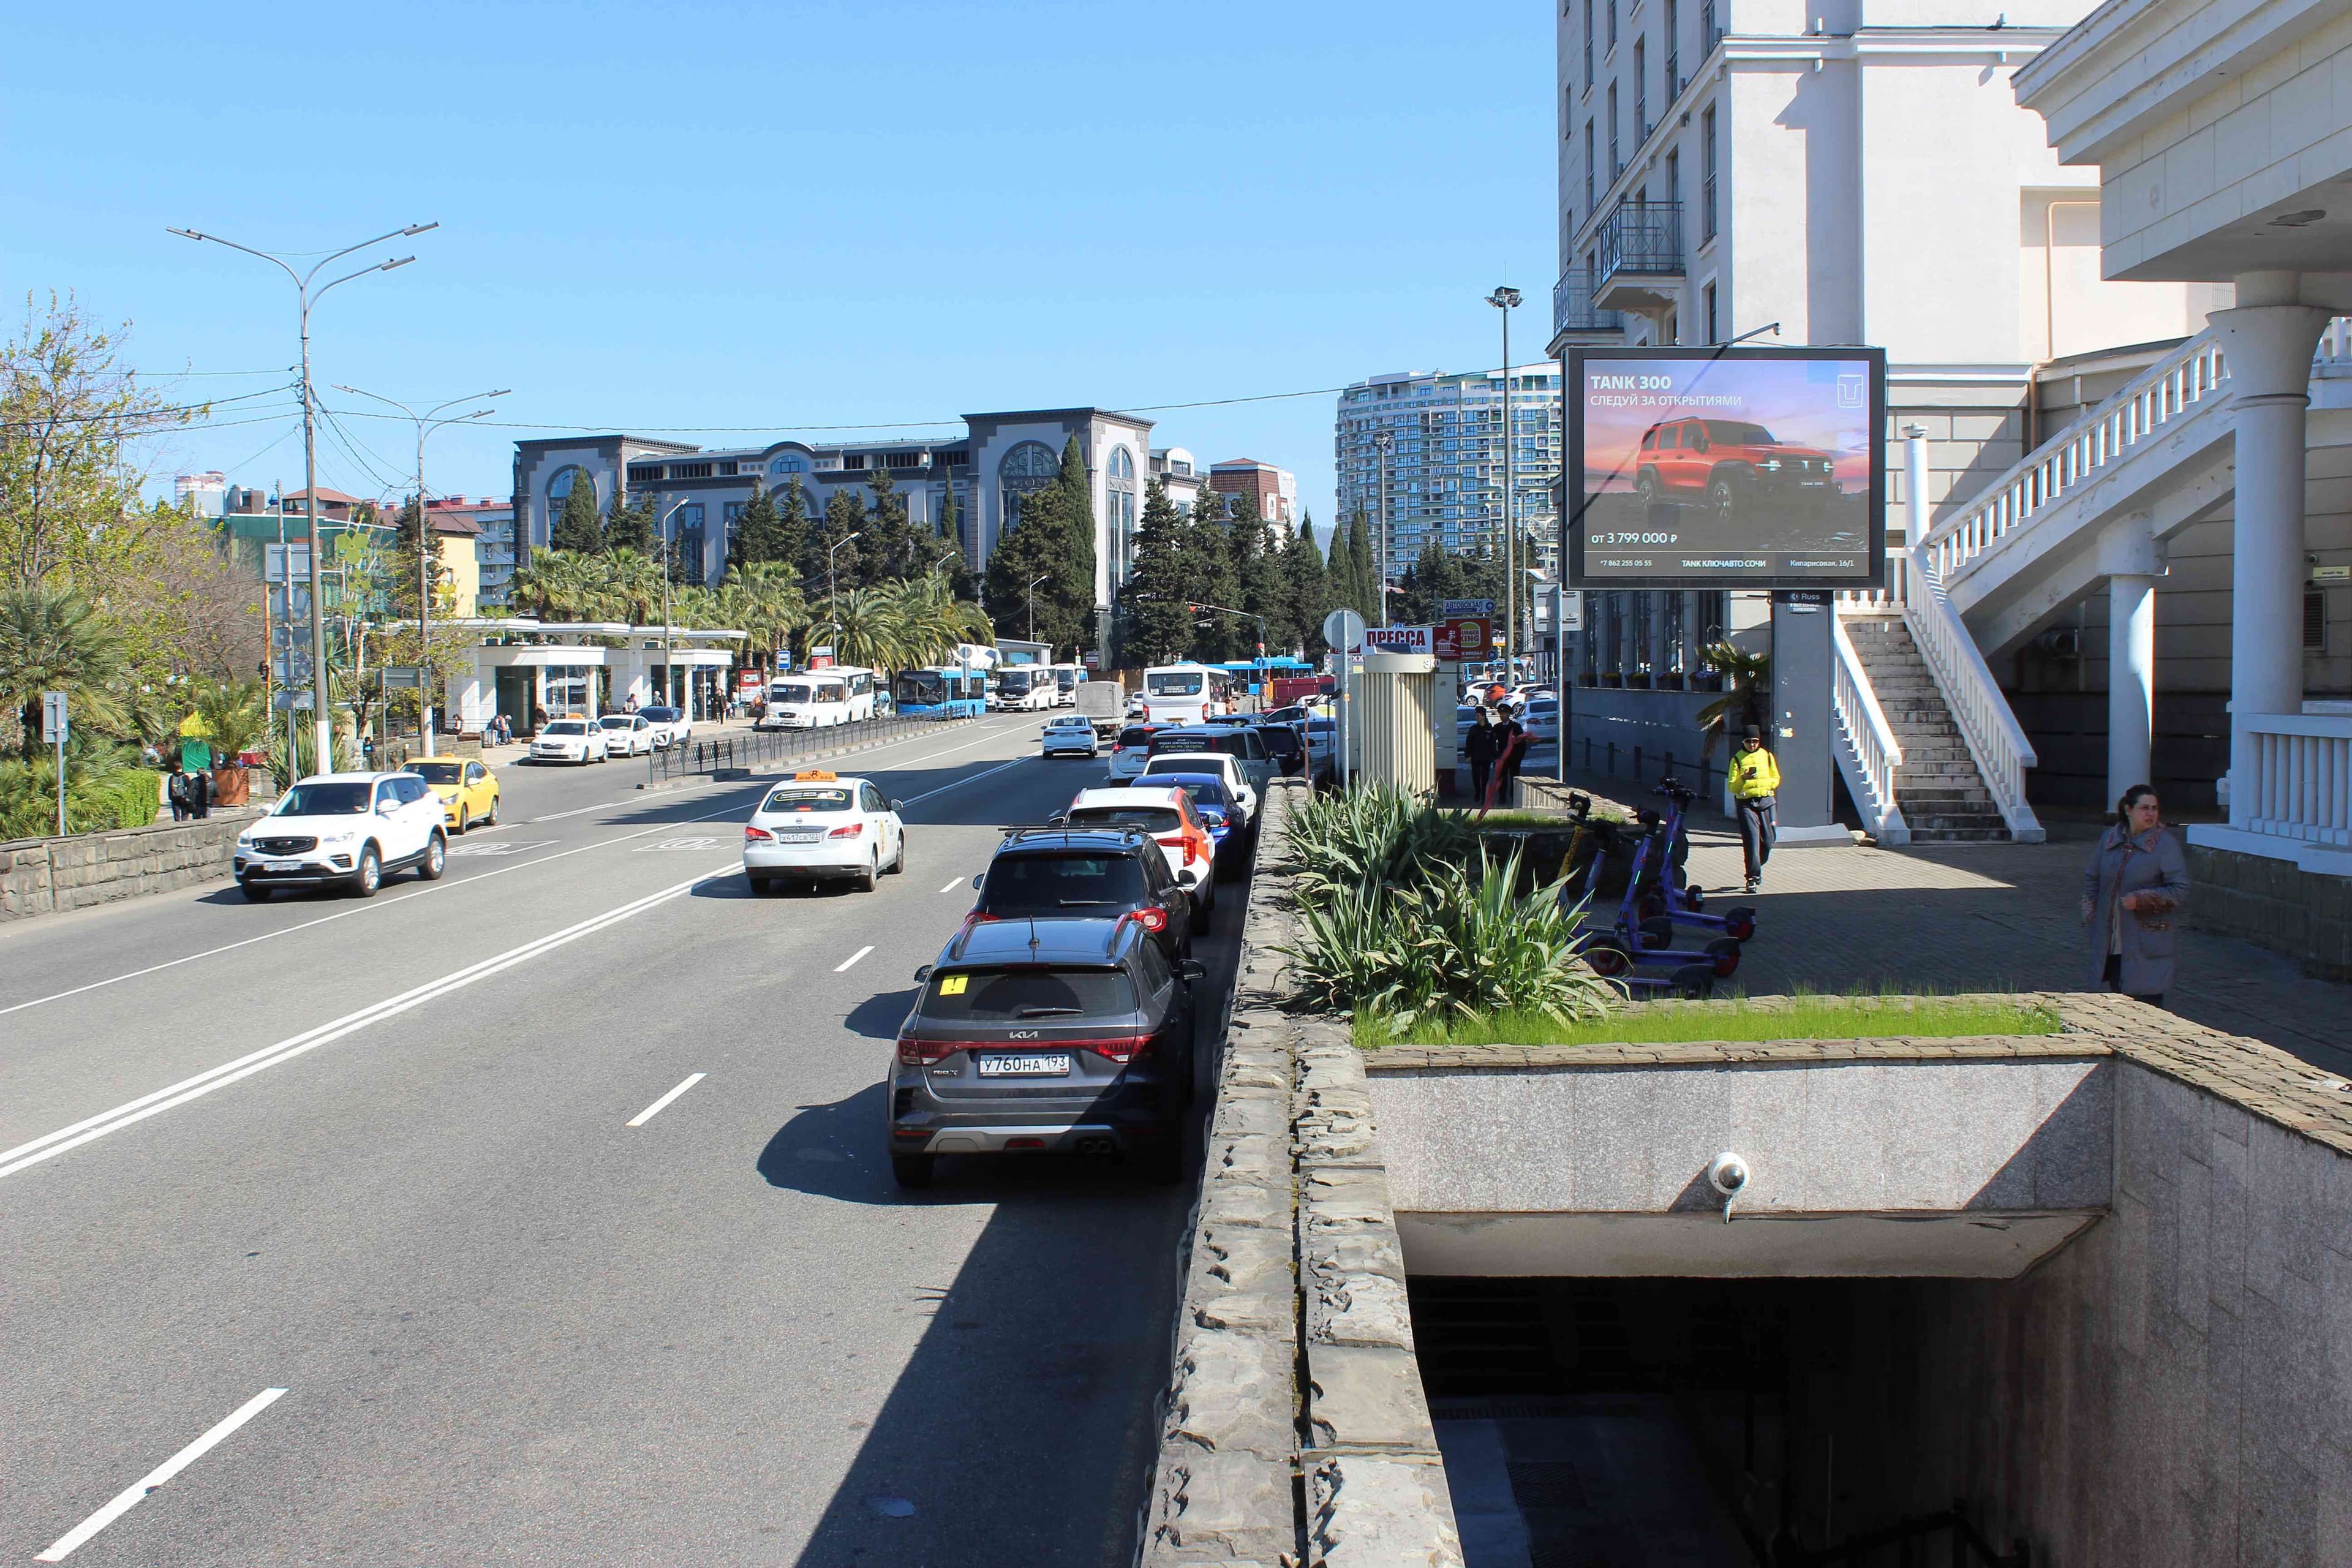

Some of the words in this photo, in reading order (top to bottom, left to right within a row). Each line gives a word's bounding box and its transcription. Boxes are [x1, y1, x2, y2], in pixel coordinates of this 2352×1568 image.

[1591, 376, 1635, 390] TANK
[1640, 376, 1672, 390] 300
[1591, 393, 1638, 407] СЛЕДУЙ
[1642, 396, 1655, 405] ЗА
[1659, 396, 1741, 405] ОТКРЫТИЯМИ
[1591, 535, 1605, 543] от
[1607, 532, 1615, 543] 3
[1617, 532, 1640, 543] 799
[1642, 532, 1667, 543] 000
[1790, 560, 1837, 568] Кипарисовая,
[1366, 630, 1426, 647] ПРЕССА
[985, 1057, 1041, 1072] У760НА
[1044, 1055, 1066, 1068] 193
